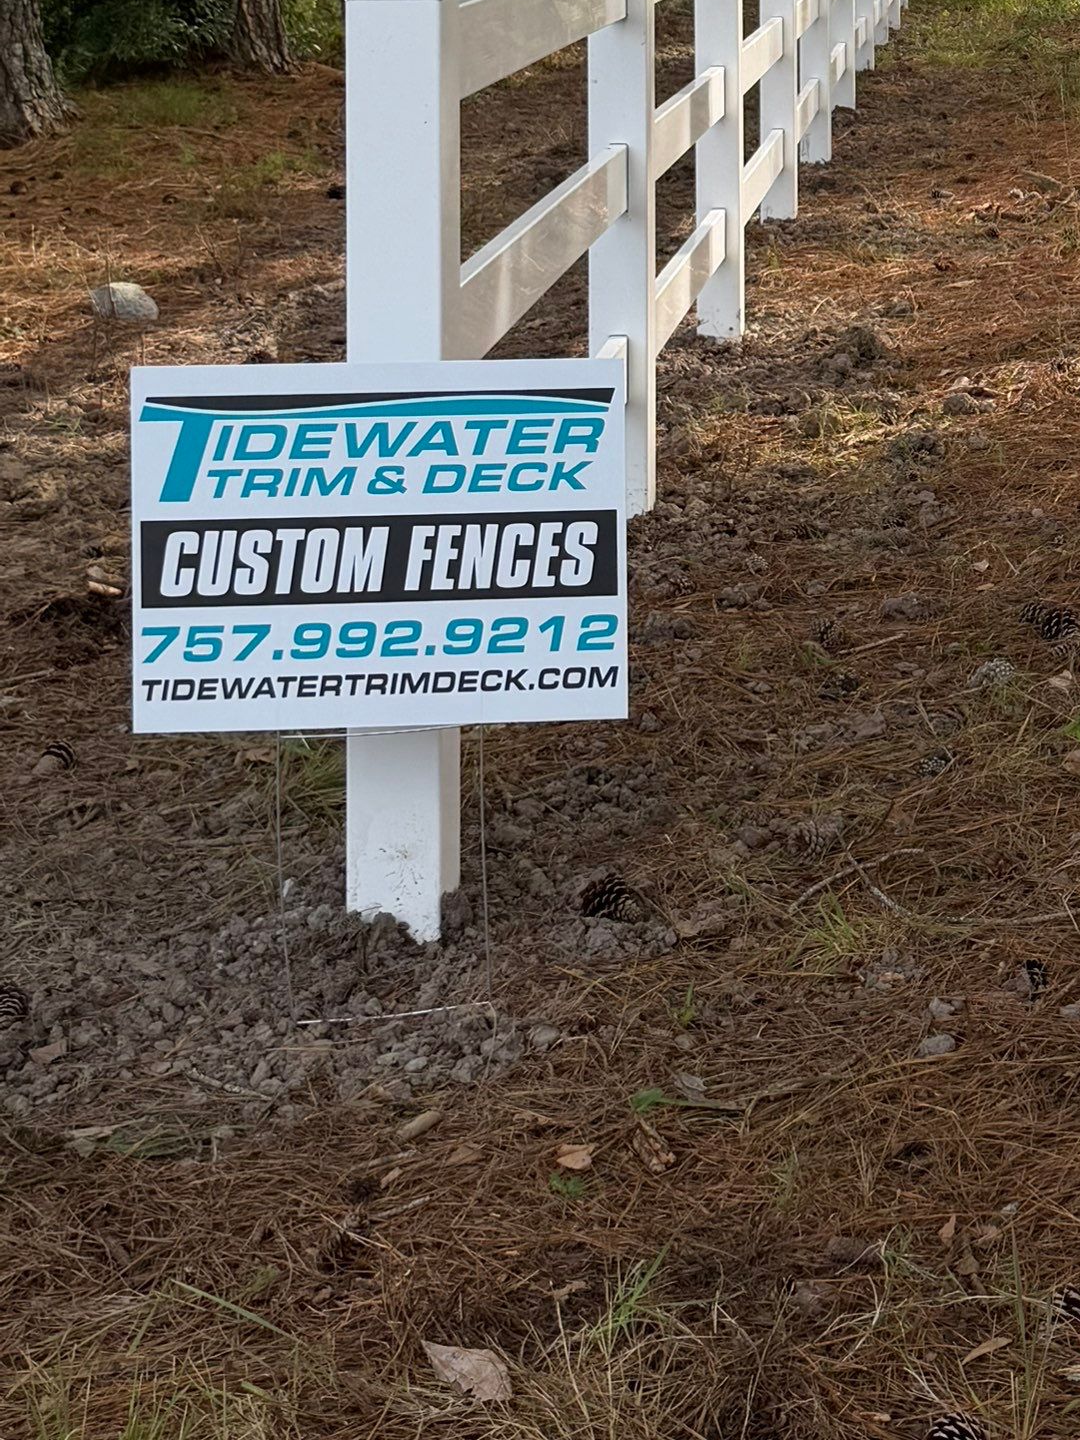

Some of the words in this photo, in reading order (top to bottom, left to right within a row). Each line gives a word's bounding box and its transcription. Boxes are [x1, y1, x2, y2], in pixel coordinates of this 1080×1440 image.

[139, 395, 610, 503] TIDEWATER
[206, 466, 357, 499] TRIM
[368, 465, 408, 495] &
[422, 461, 594, 494] DECK
[159, 526, 390, 597] CUSTOM
[404, 521, 600, 591] FENCES
[141, 614, 619, 664] 757.992.9212
[141, 666, 619, 702] TIDEWATERTRIMDECK.COM
